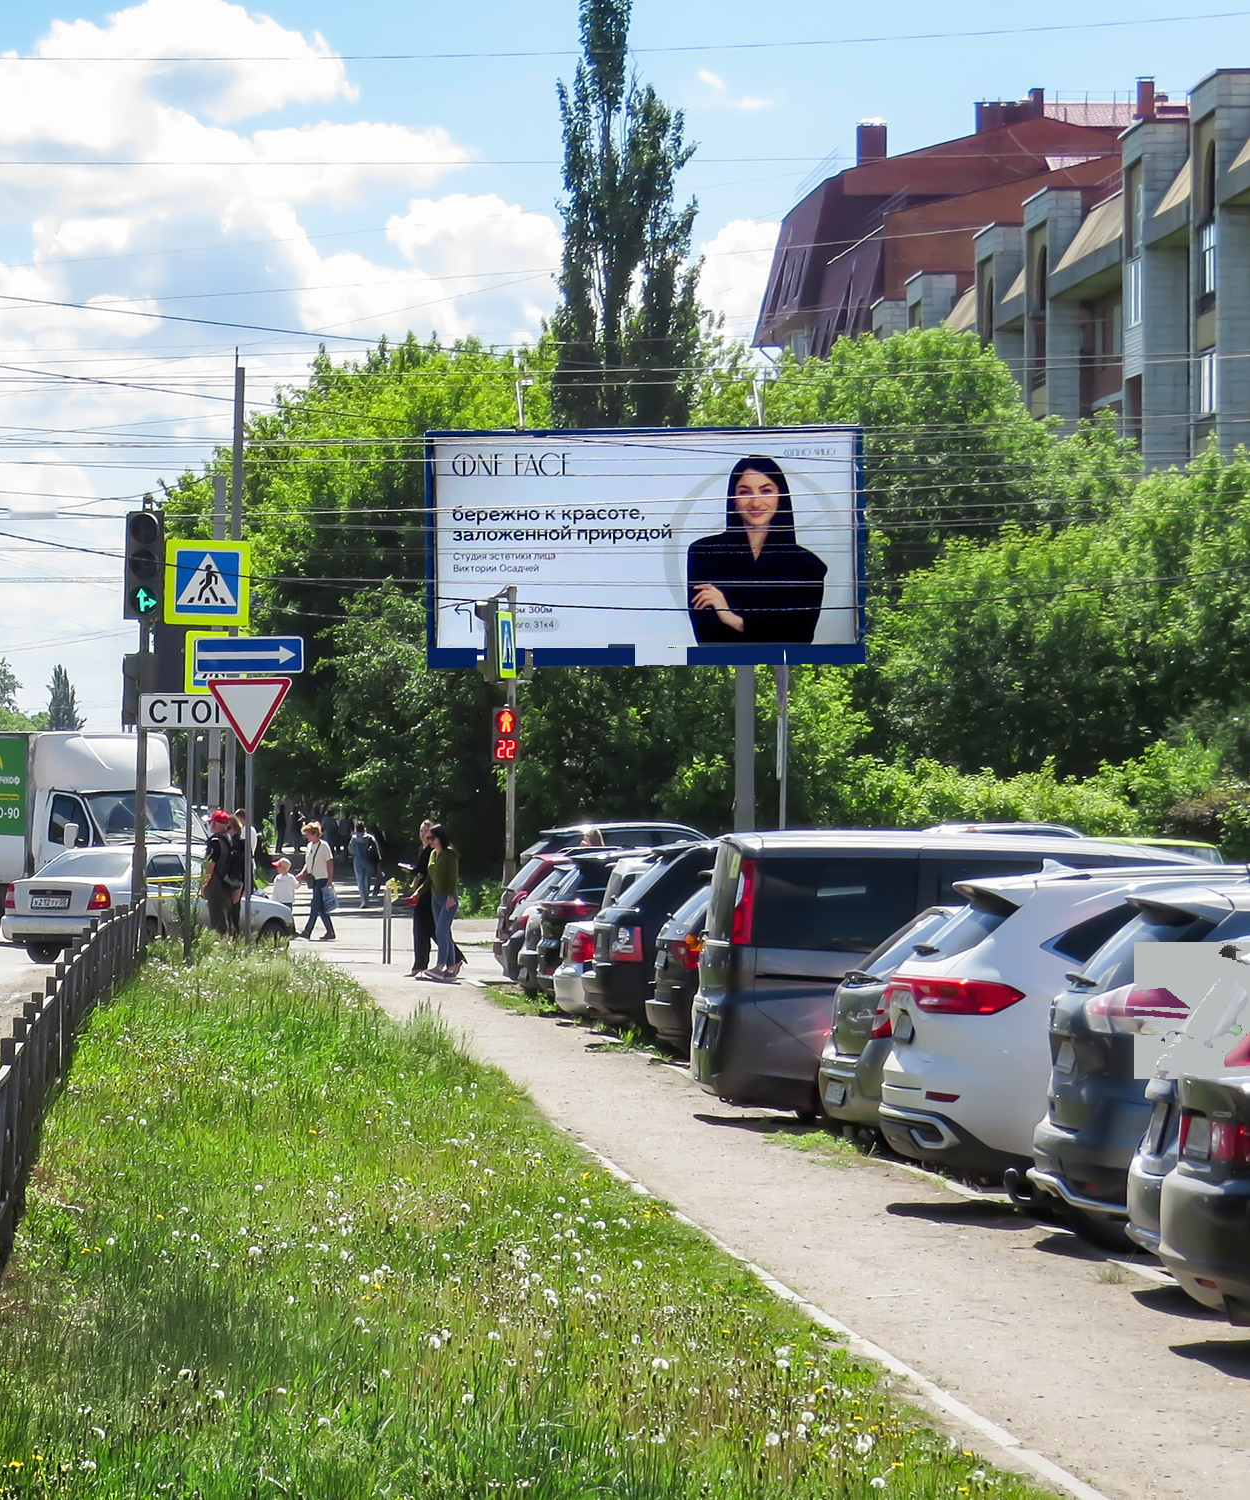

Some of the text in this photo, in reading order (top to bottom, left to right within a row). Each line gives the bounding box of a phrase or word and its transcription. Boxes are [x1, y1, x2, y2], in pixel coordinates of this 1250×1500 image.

[515, 453, 575, 476] FACE
[453, 506, 645, 525] бережно к красоте,
[453, 524, 672, 544] заложенной природой
[453, 552, 556, 562] Студия эстетики лица
[453, 564, 539, 573] Виктории Осадчей
[529, 606, 553, 614] 300м
[534, 621, 554, 629] 31к4
[497, 739, 516, 759] 22
